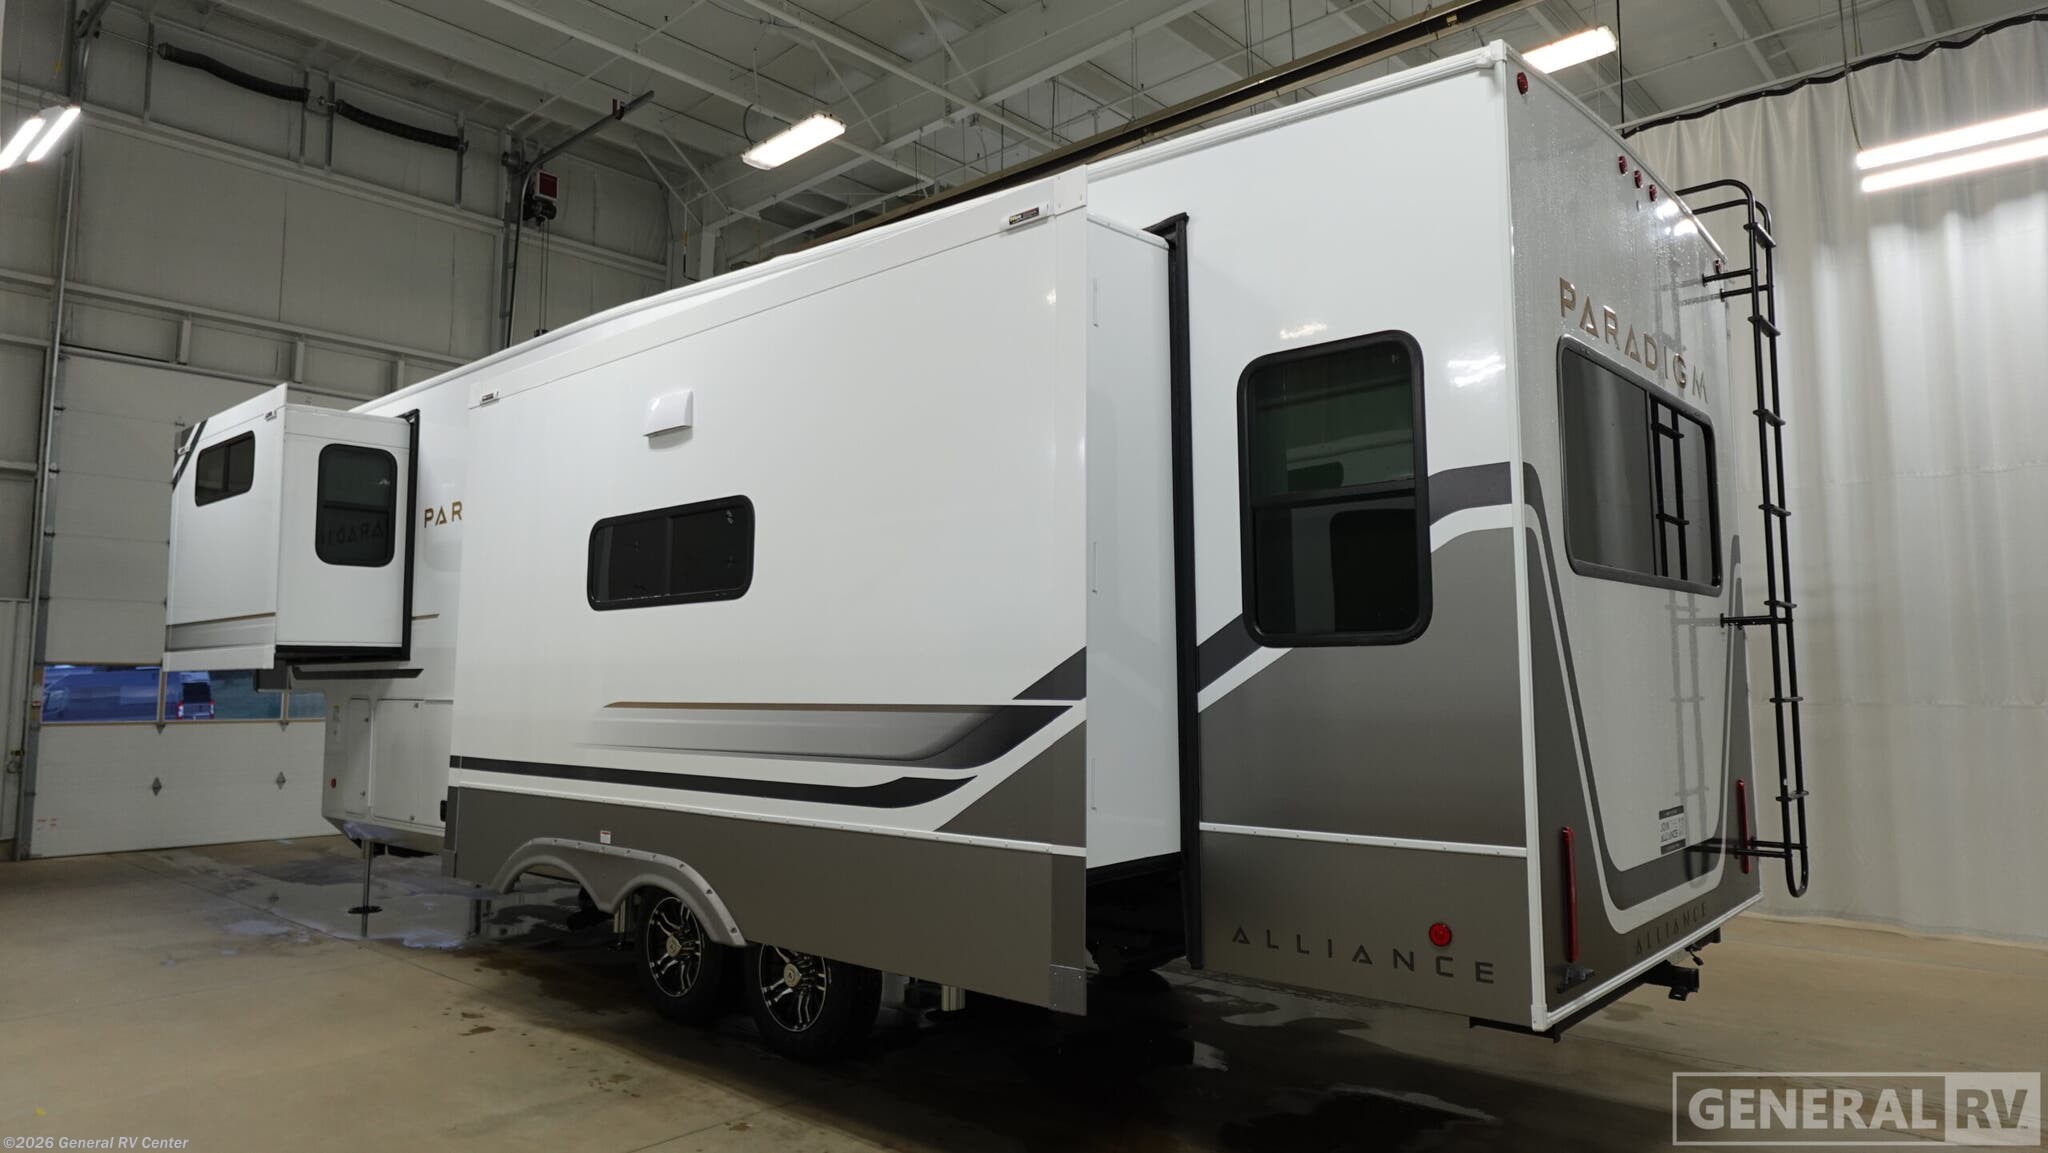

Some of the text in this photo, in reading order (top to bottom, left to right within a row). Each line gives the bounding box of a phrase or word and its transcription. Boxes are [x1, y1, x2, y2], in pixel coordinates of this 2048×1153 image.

[1559, 276, 1709, 405] PARADIGM
[1231, 926, 1495, 984] ALLIANCE
[1636, 902, 1706, 955] ALLIANCE
